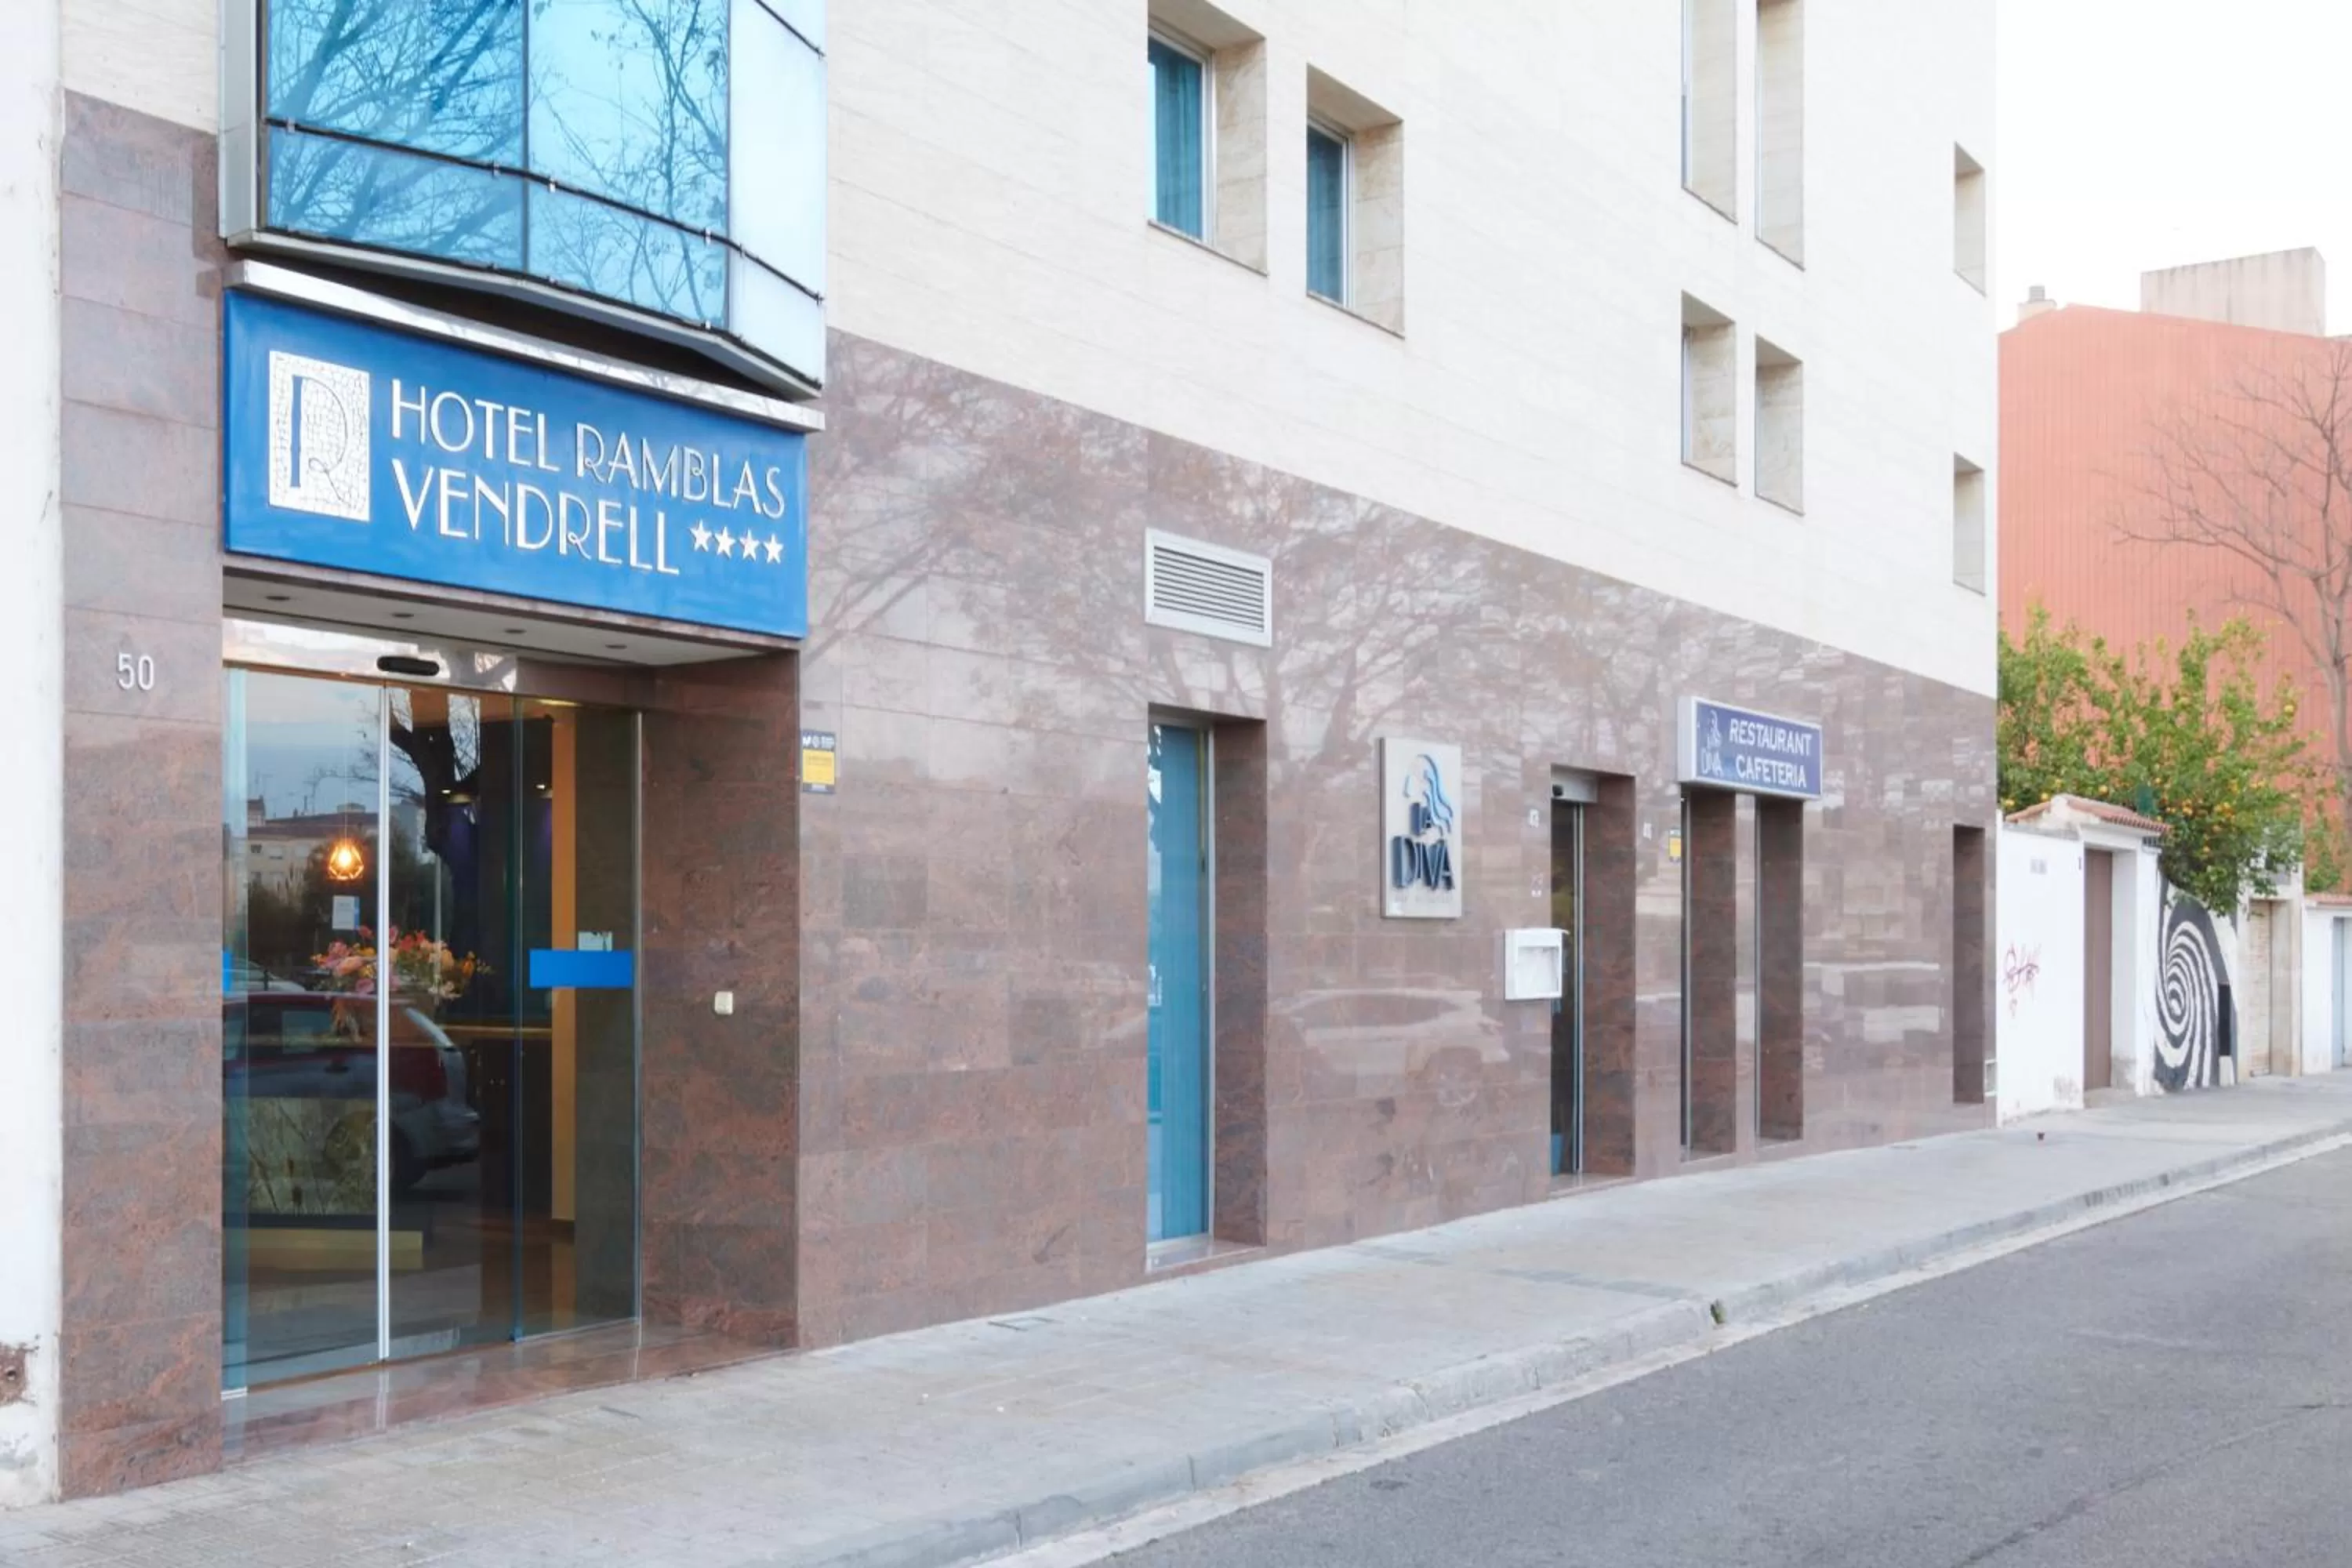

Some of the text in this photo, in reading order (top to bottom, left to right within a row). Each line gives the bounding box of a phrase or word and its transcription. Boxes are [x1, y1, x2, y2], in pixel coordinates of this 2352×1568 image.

[391, 379, 785, 518] HOTEL RAMBLAS
[392, 459, 680, 575] VENDRELL
[118, 652, 154, 690] 50
[1730, 718, 1812, 756] RESTAURANT
[1735, 754, 1807, 787] CAFETERIA
[1392, 836, 1455, 891] DIVA
